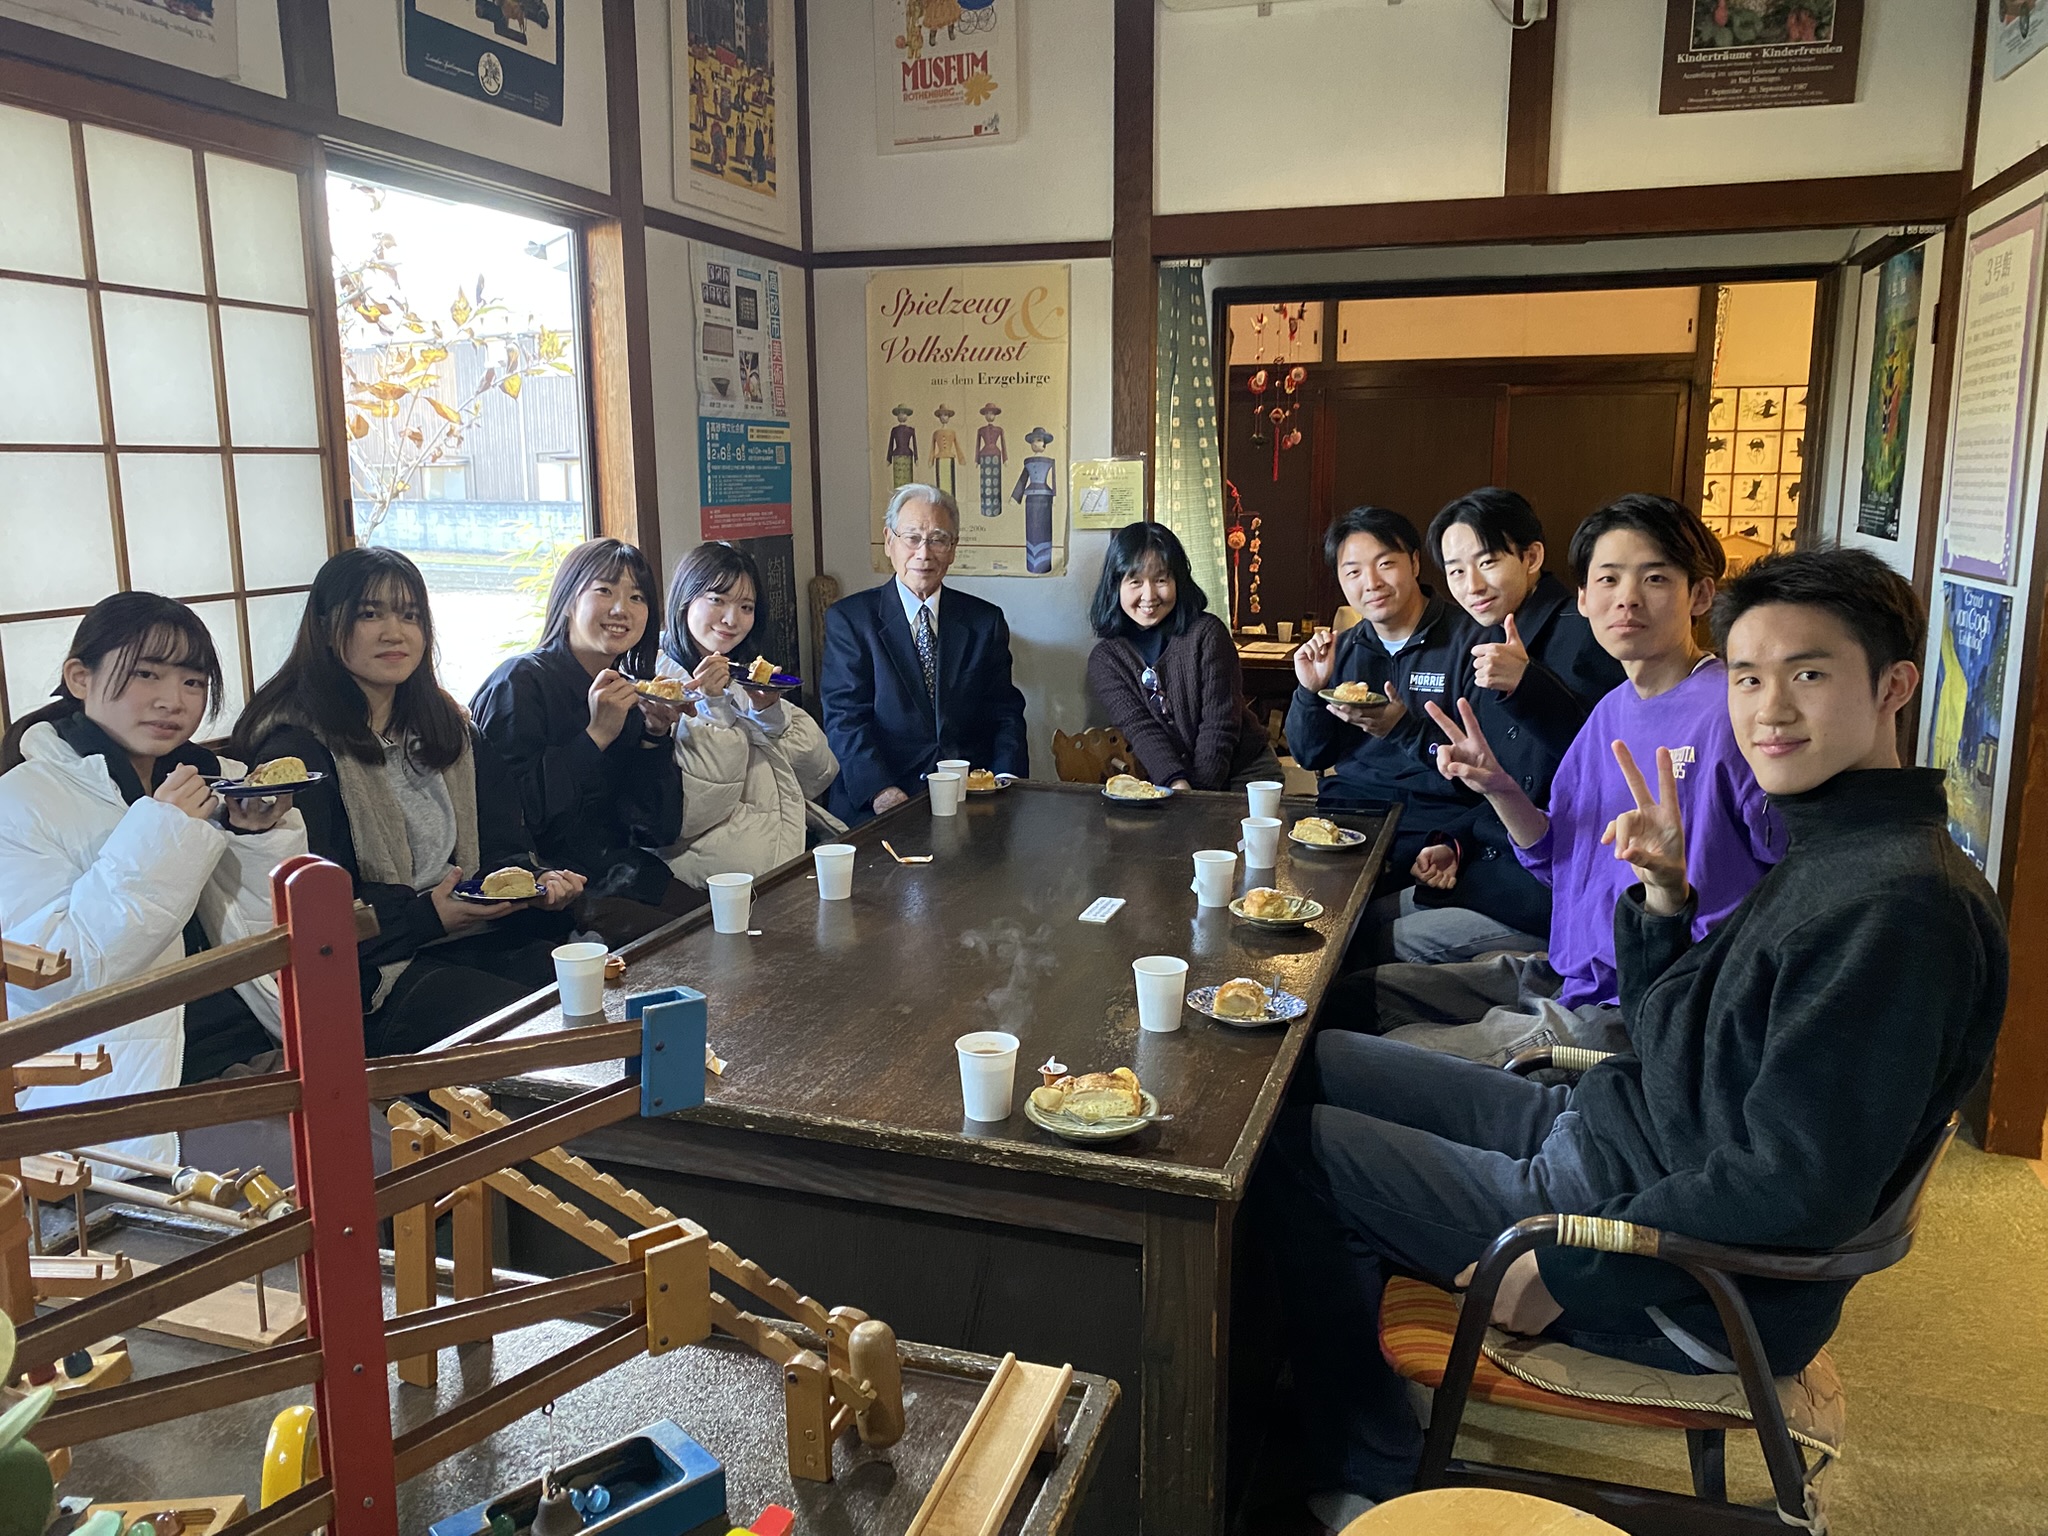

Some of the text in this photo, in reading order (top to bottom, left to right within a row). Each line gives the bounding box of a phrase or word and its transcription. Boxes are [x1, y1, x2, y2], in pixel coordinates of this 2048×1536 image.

[1677, 50, 1752, 63] Kinderträume
[1762, 44, 1843, 58] Kinderfreuden
[901, 50, 988, 92] MUSEUM
[903, 88, 955, 102] ROTHENBURG
[1985, 250, 2013, 287] 3号館
[880, 287, 1014, 328] Spielzeug
[881, 335, 1029, 364] Volkskunst
[931, 372, 1051, 388] aus dem Erzgebirge
[1410, 674, 1445, 686] MORRIE
